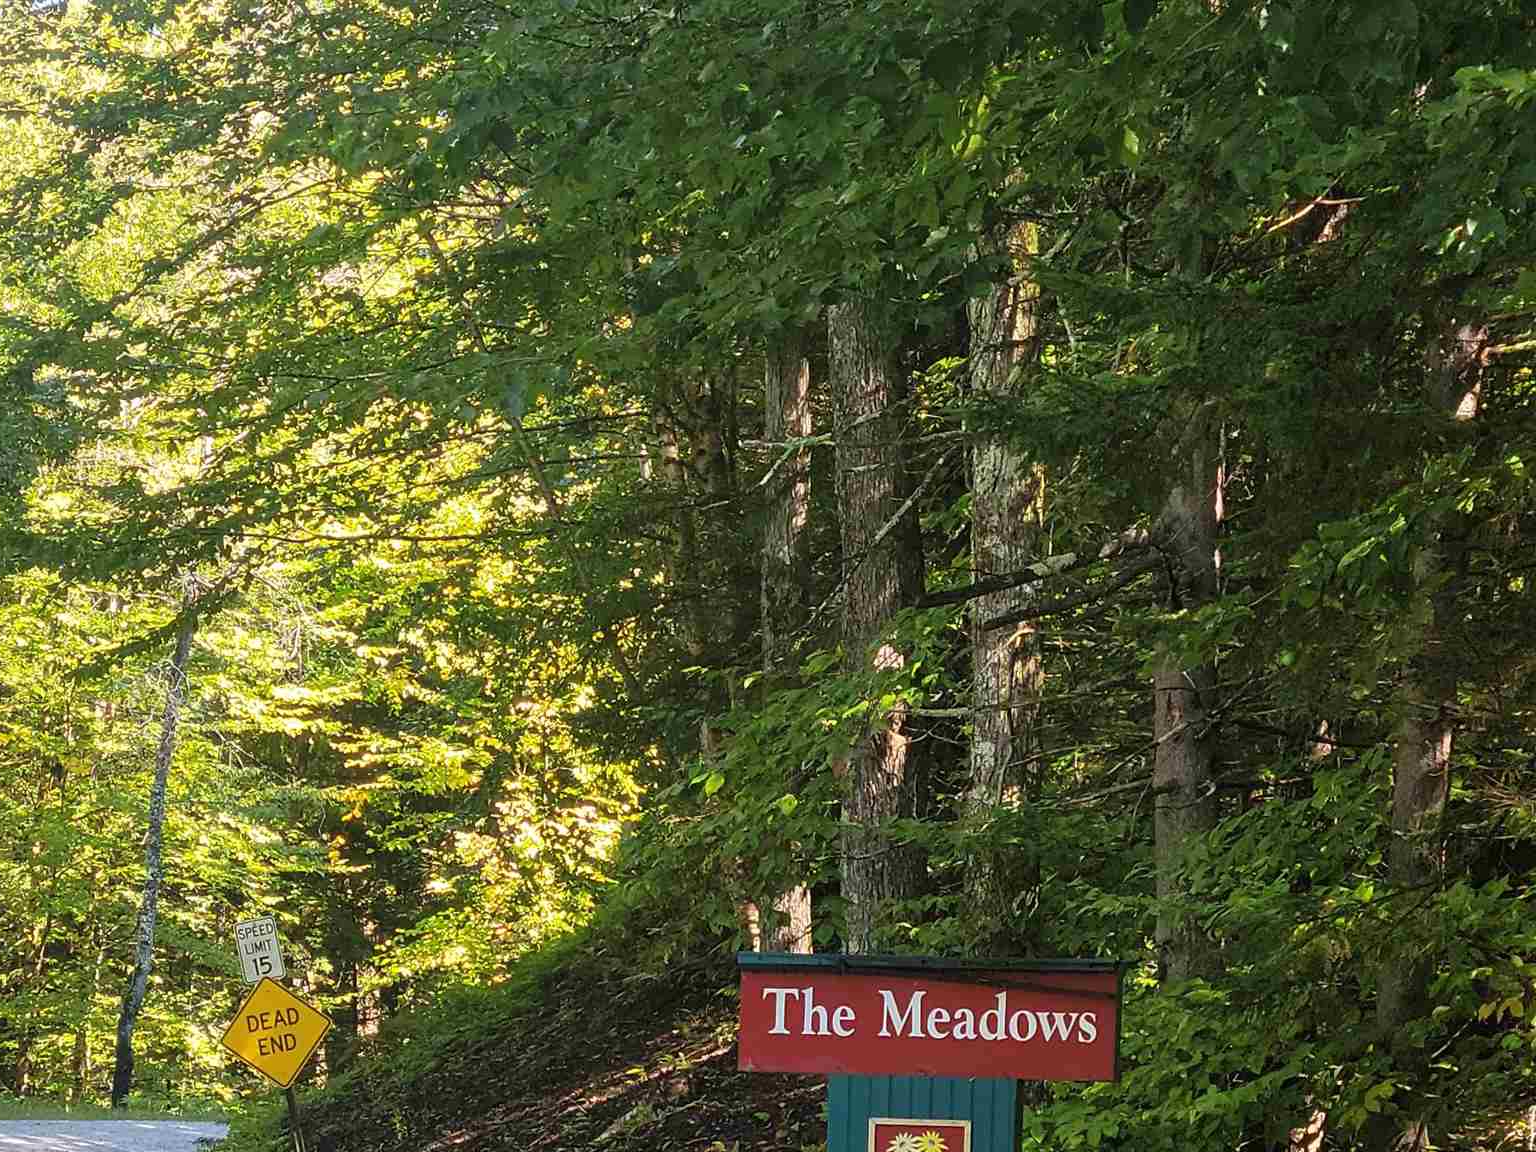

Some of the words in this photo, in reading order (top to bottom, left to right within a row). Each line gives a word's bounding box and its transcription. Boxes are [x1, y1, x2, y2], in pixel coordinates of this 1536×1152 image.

[238, 923, 273, 940] SPEED
[244, 939, 271, 955] LIMIT
[252, 956, 272, 976] 15
[246, 1007, 300, 1033] DEAD
[762, 986, 856, 1037] The
[877, 989, 1097, 1044] Meadows
[258, 1033, 297, 1056] END
